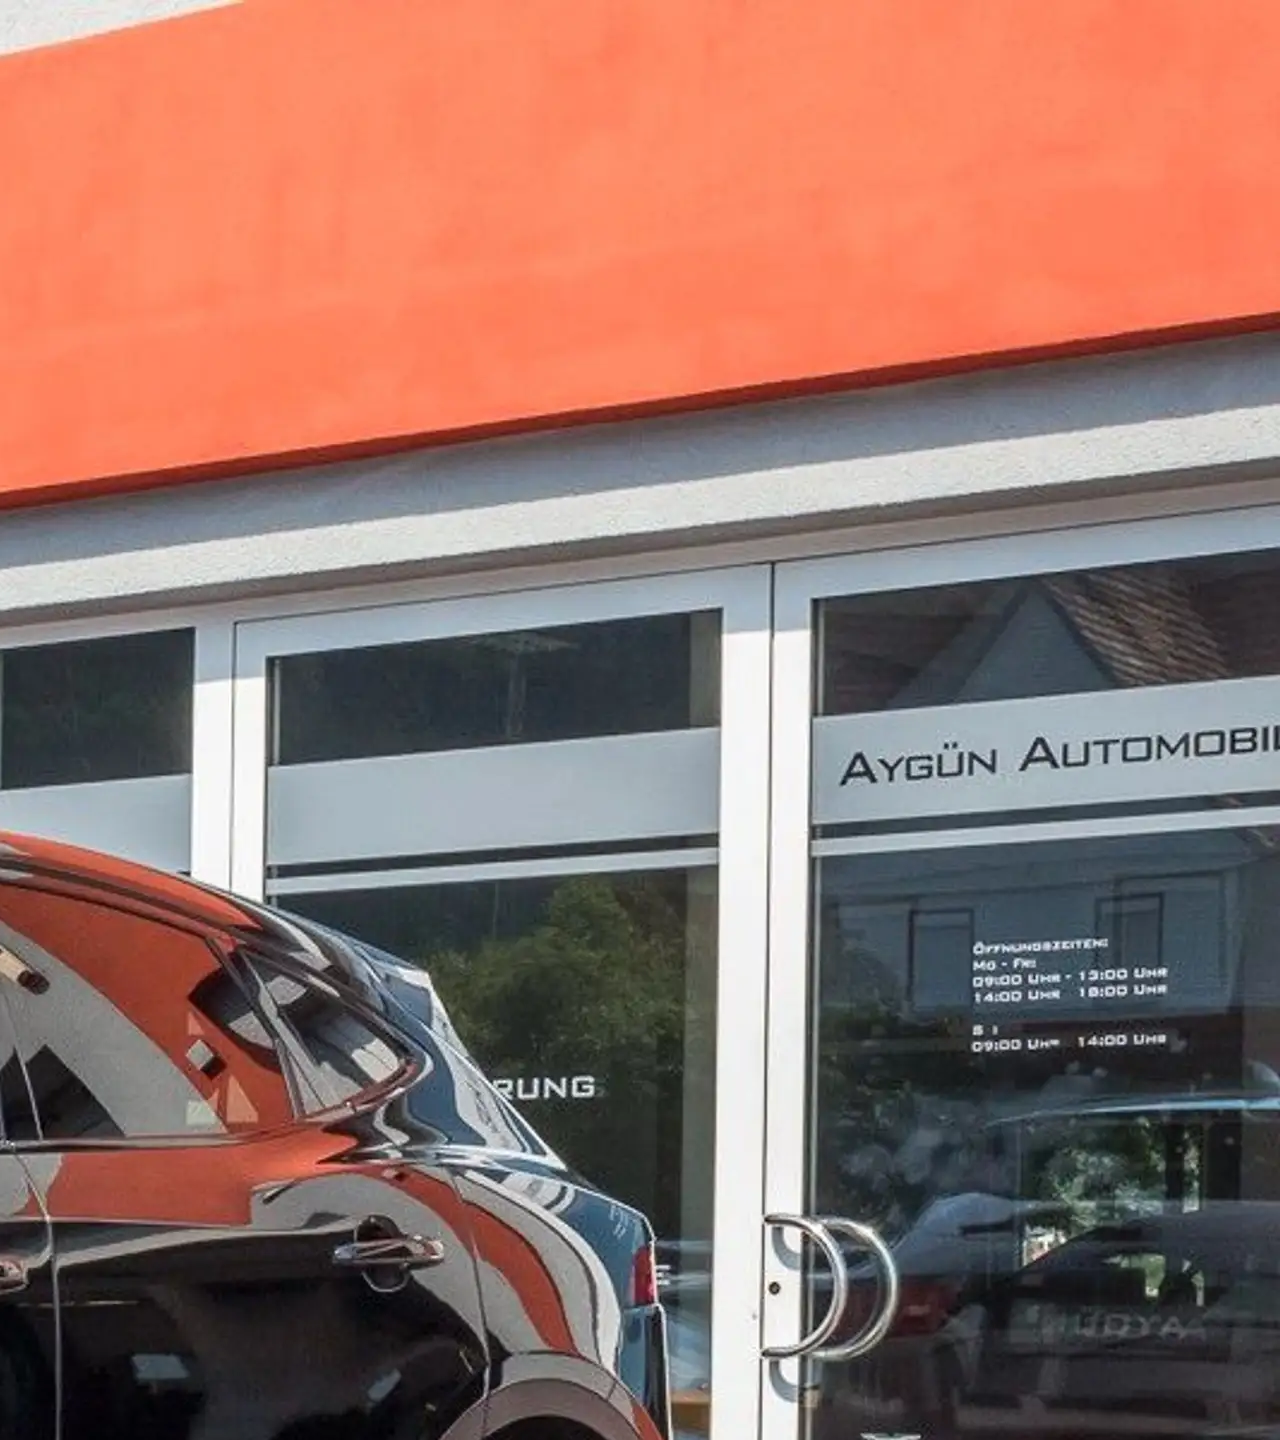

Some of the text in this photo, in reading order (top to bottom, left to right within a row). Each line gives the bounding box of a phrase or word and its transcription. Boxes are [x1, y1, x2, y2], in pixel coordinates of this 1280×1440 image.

[840, 742, 997, 787] AYGÜN
[972, 960, 997, 972] MO
[972, 974, 1023, 988] 09:00
